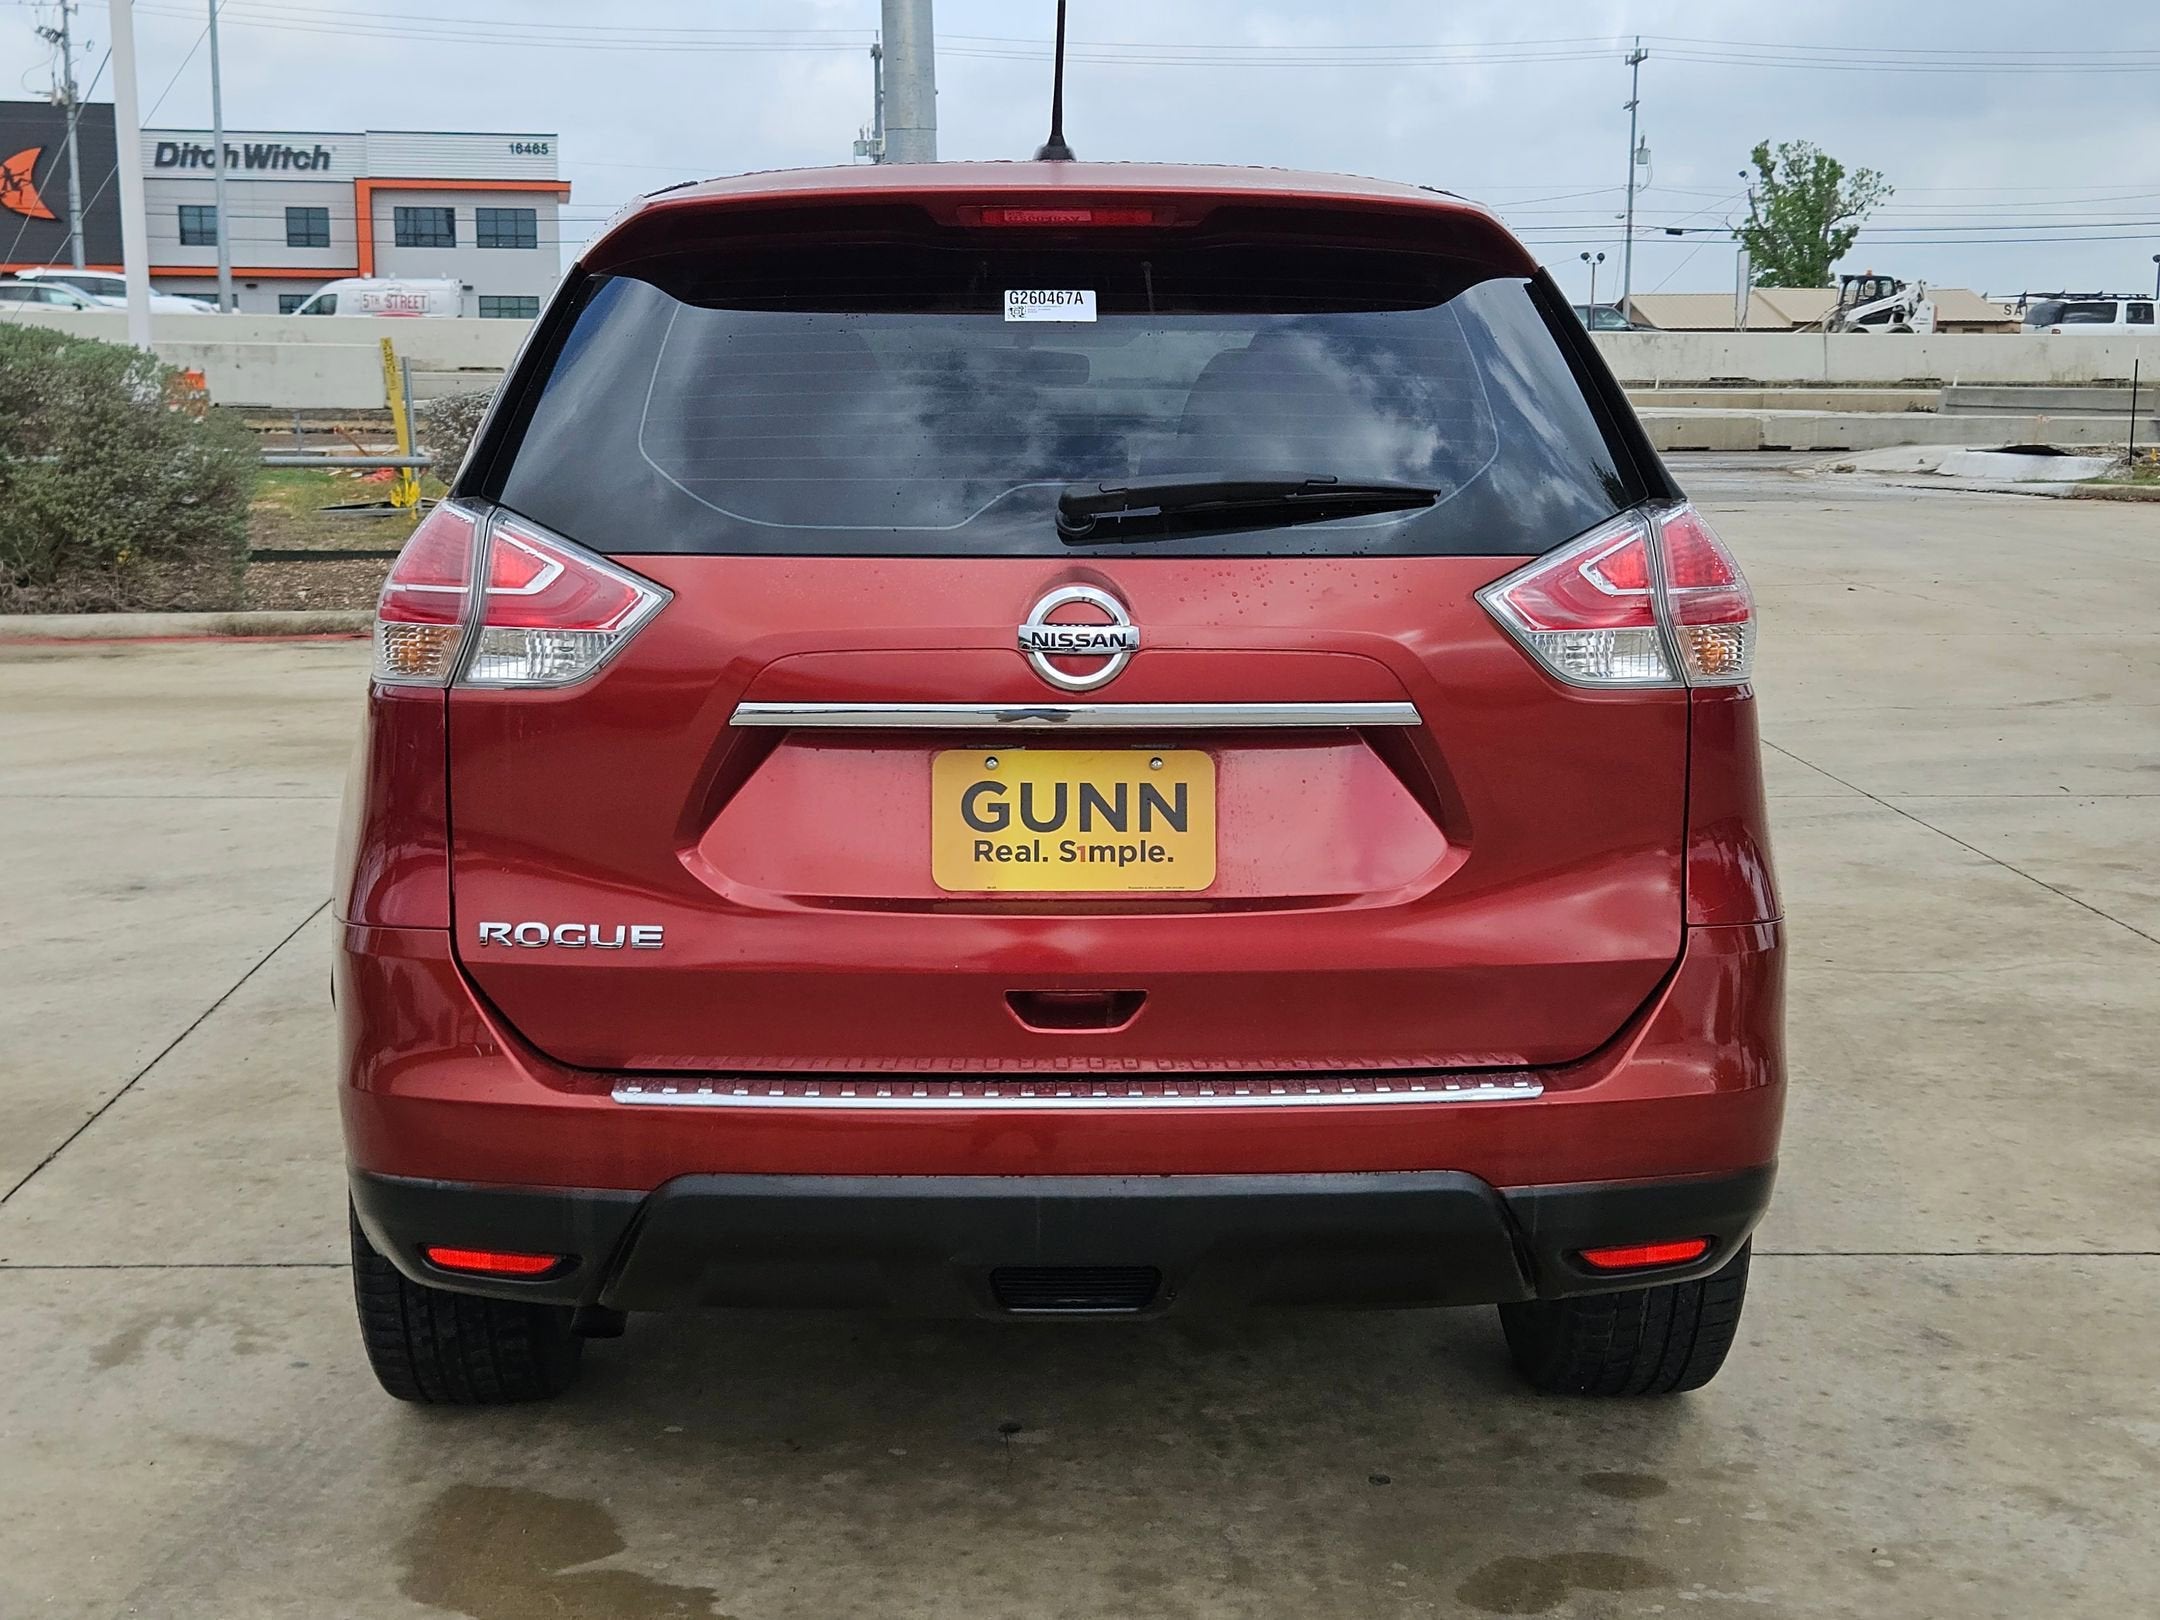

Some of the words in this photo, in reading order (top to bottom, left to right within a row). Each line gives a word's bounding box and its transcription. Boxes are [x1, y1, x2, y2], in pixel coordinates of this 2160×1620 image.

[154, 142, 240, 168] Ditch
[244, 143, 332, 170] Witch
[385, 294, 427, 310] STREET
[1009, 290, 1084, 305] G260467A
[1031, 632, 1127, 648] NISSAN
[960, 780, 1188, 833] GUNN
[974, 839, 1049, 863] Real.
[479, 921, 665, 949] ROGUE
